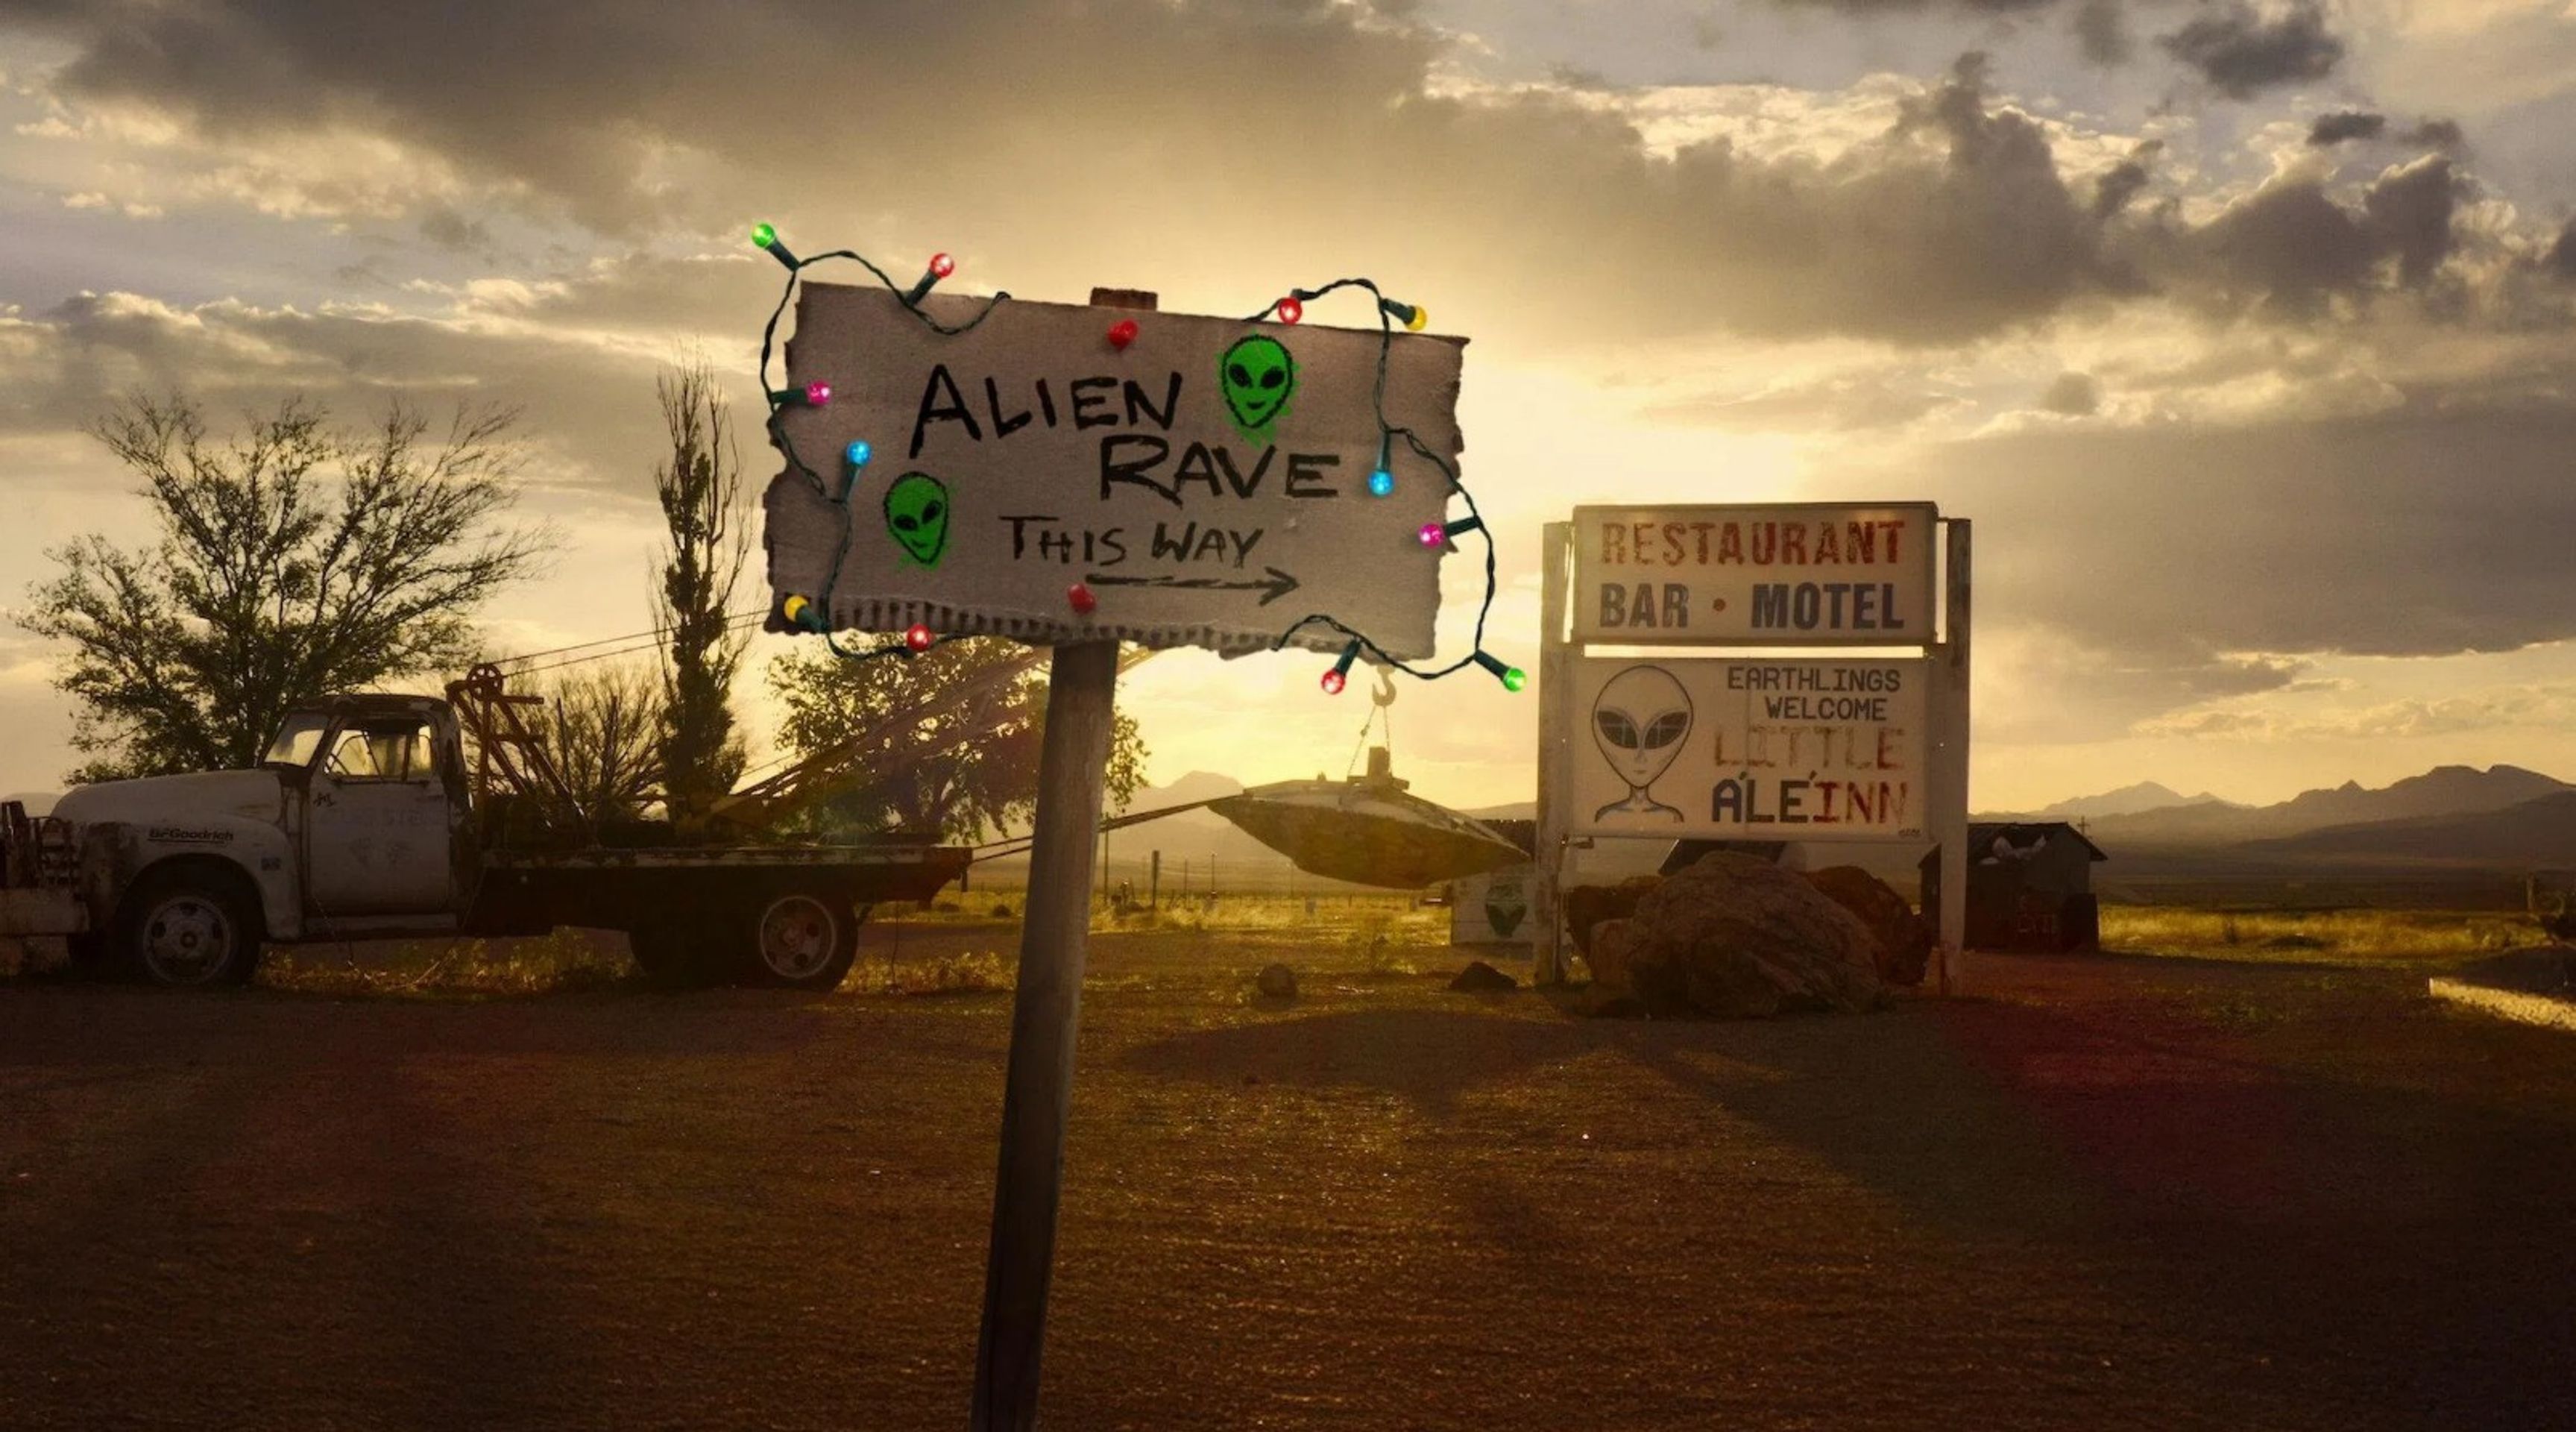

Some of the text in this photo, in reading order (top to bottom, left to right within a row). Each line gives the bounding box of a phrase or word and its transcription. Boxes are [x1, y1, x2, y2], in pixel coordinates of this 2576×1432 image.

[909, 364, 1182, 459] ALIEN
[1100, 435, 1340, 508] RAVE
[999, 515, 1263, 568] THIS WAY
[1600, 519, 1905, 566] RESTAURANT
[1599, 582, 1904, 629] BAR MOTEL
[1727, 666, 1901, 692] EARTHLINGS
[1765, 697, 1887, 720] WELCOME
[1713, 724, 1905, 770] LITTLE
